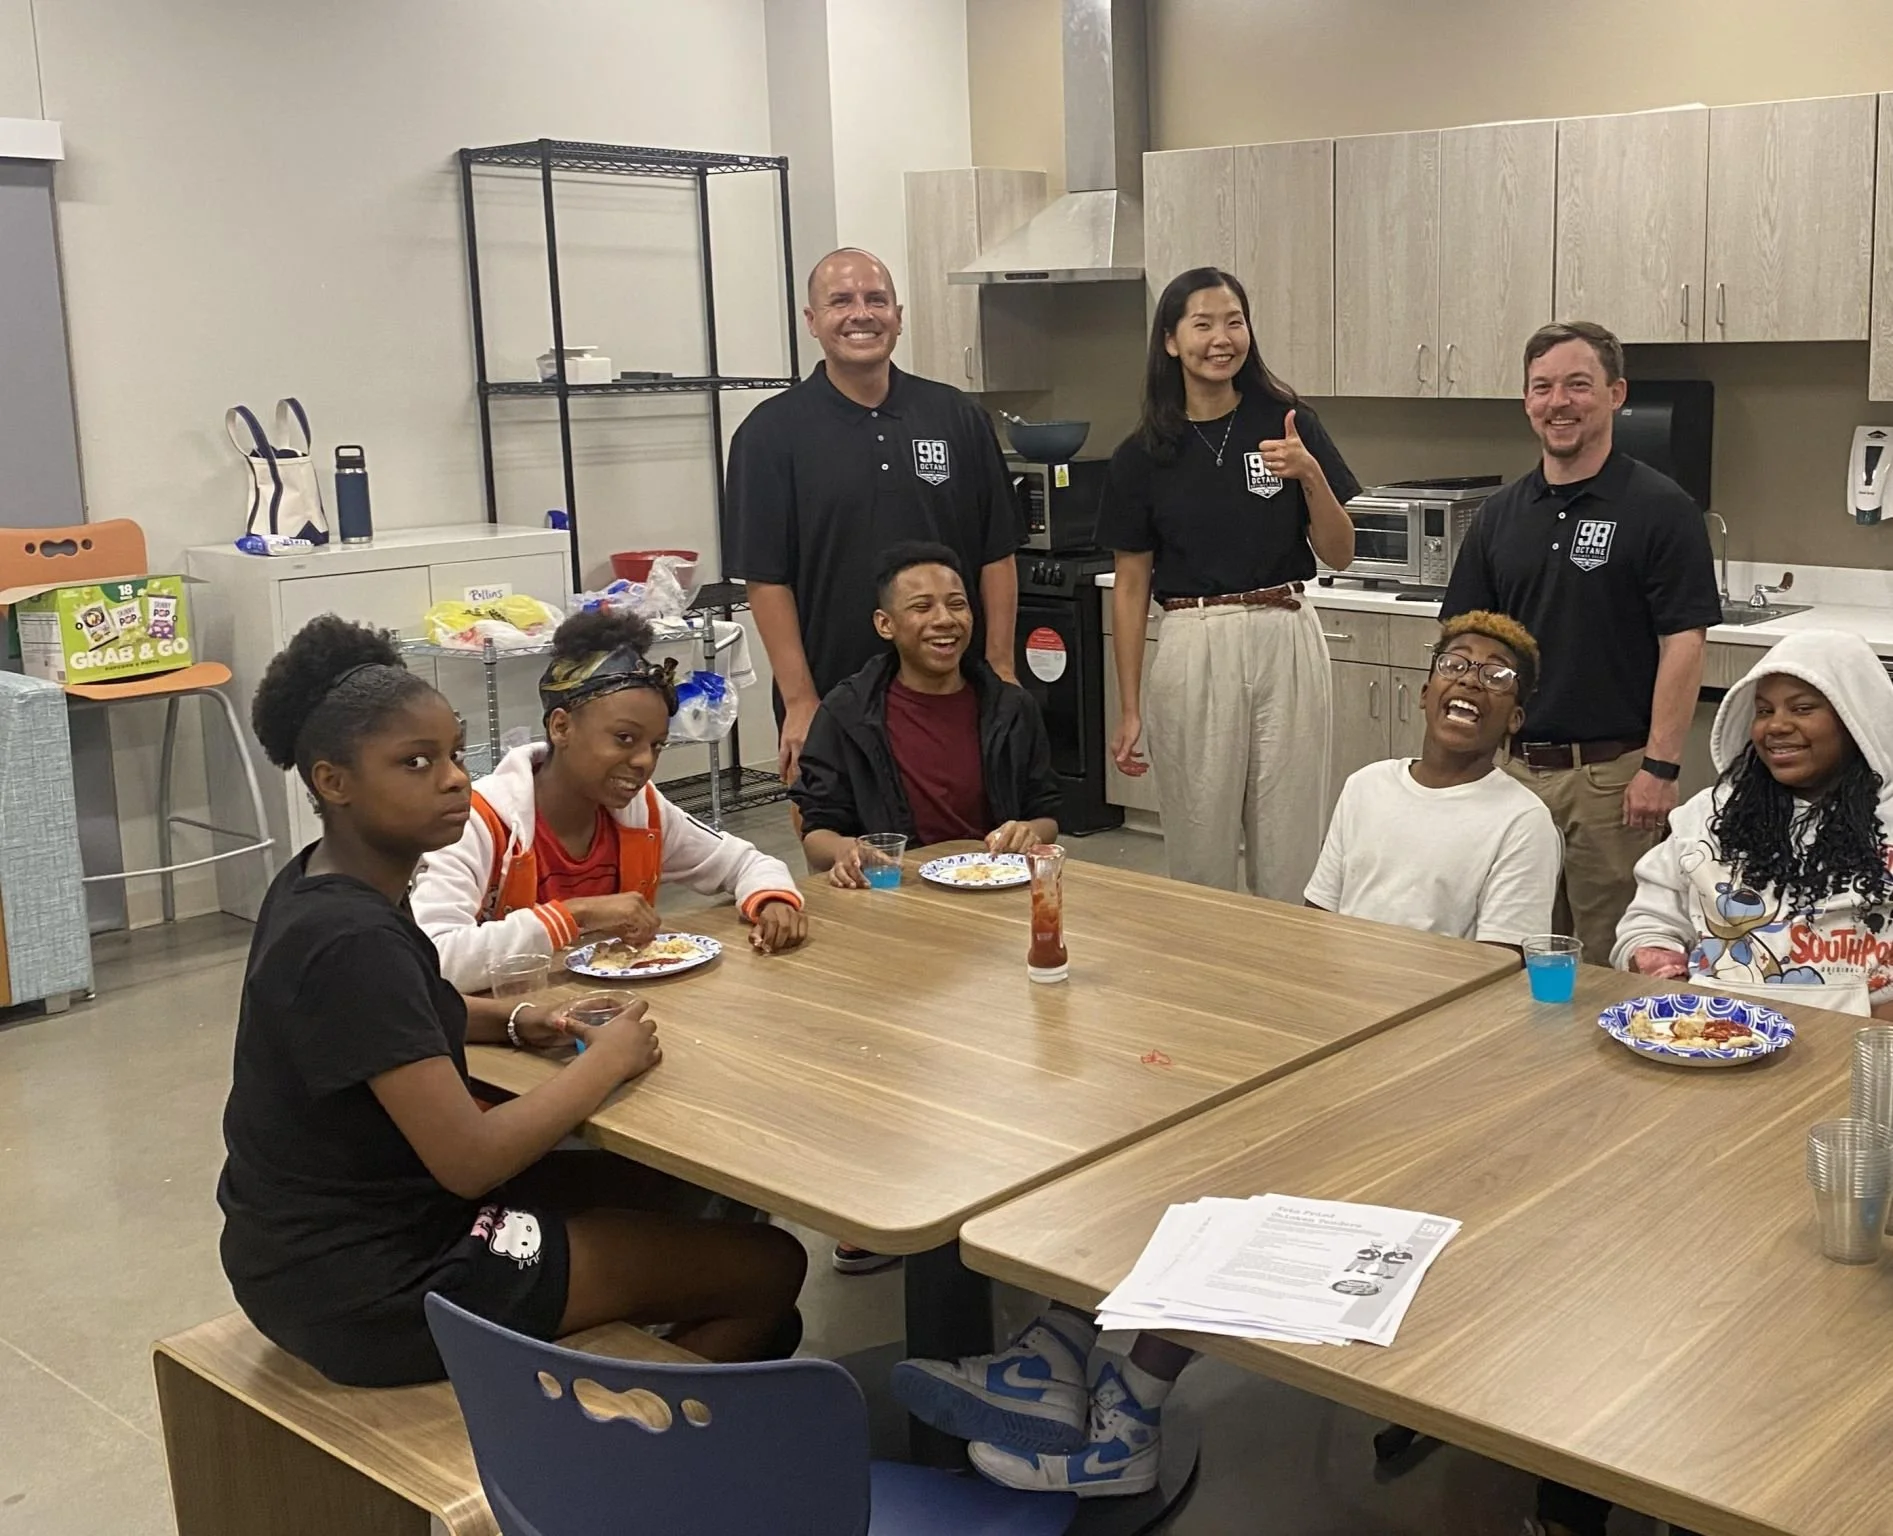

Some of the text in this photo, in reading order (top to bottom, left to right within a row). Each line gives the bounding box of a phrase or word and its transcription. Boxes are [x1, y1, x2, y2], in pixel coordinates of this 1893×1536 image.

[918, 442, 945, 464] 98
[920, 463, 946, 471] OCTANE
[1249, 454, 1272, 477] 9
[1251, 476, 1279, 484] OCTANE
[1578, 522, 1611, 547] 98
[1575, 546, 1606, 555] OCTANE
[118, 584, 133, 596] 18
[154, 609, 170, 617] POP
[119, 614, 137, 626] POP
[69, 637, 189, 670] GRAB & GO
